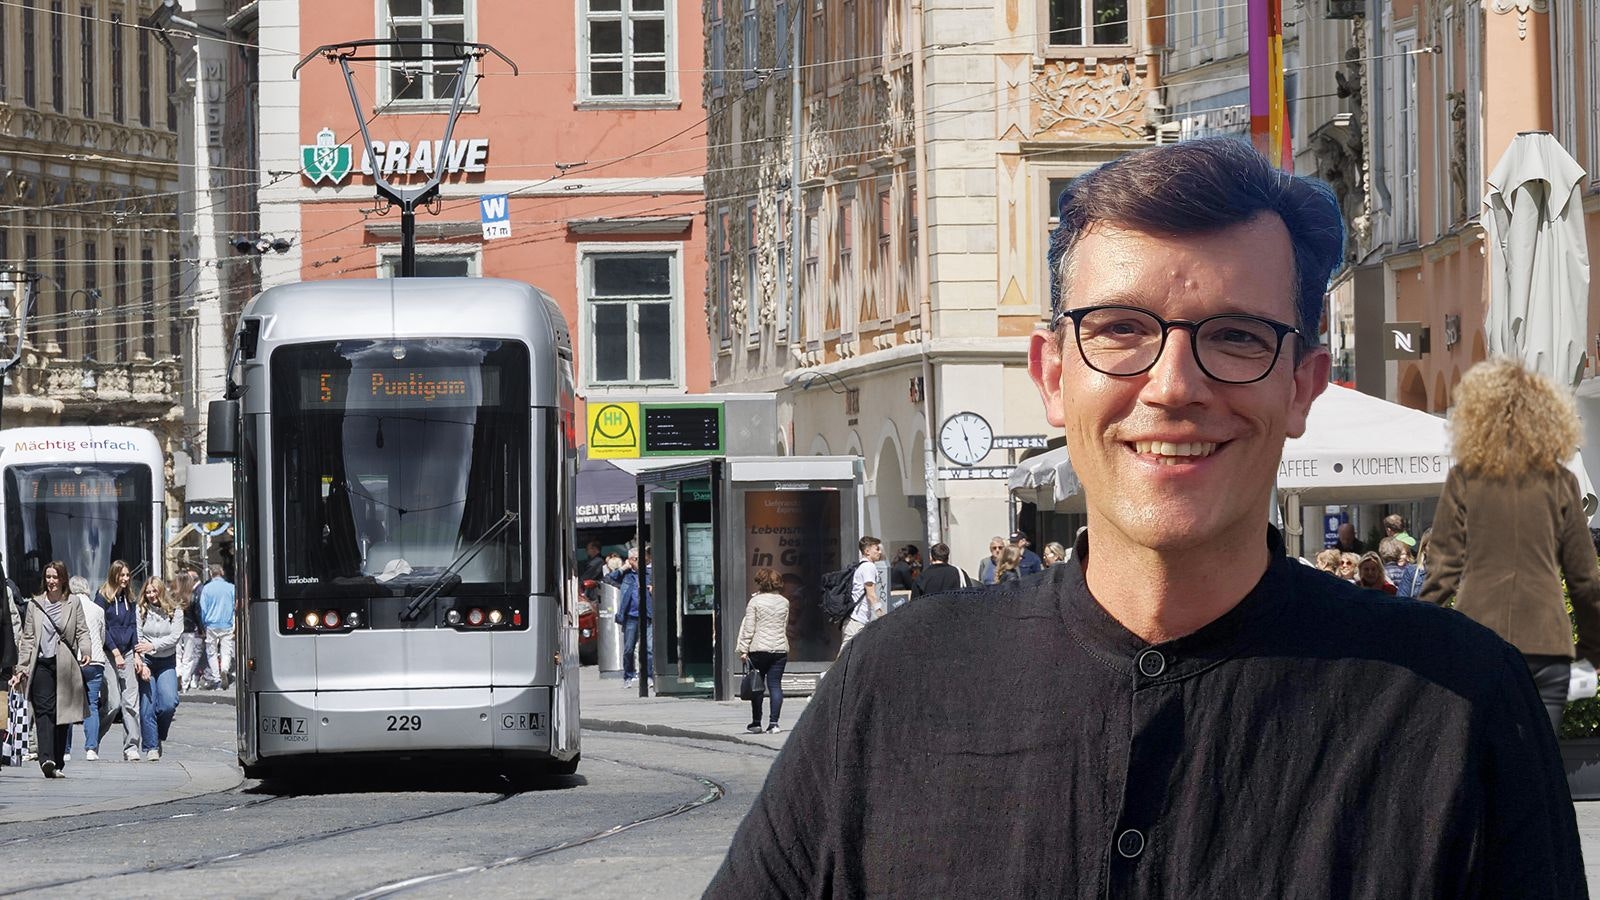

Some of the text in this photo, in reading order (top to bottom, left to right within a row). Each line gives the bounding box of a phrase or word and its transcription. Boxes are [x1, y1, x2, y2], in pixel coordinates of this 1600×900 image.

[361, 138, 489, 176] GRAWE
[482, 197, 505, 219] W
[320, 373, 465, 402] 5 Puntigam
[15, 439, 140, 452] Mächtig einfach.
[1352, 457, 1407, 476] KUCHEN,
[1410, 456, 1429, 473] EIS
[1432, 455, 1441, 473] &
[32, 481, 39, 497] 7
[752, 547, 774, 567] in
[262, 717, 305, 733] GRAZ
[387, 715, 422, 731] 229
[503, 715, 545, 729] GRAZ
